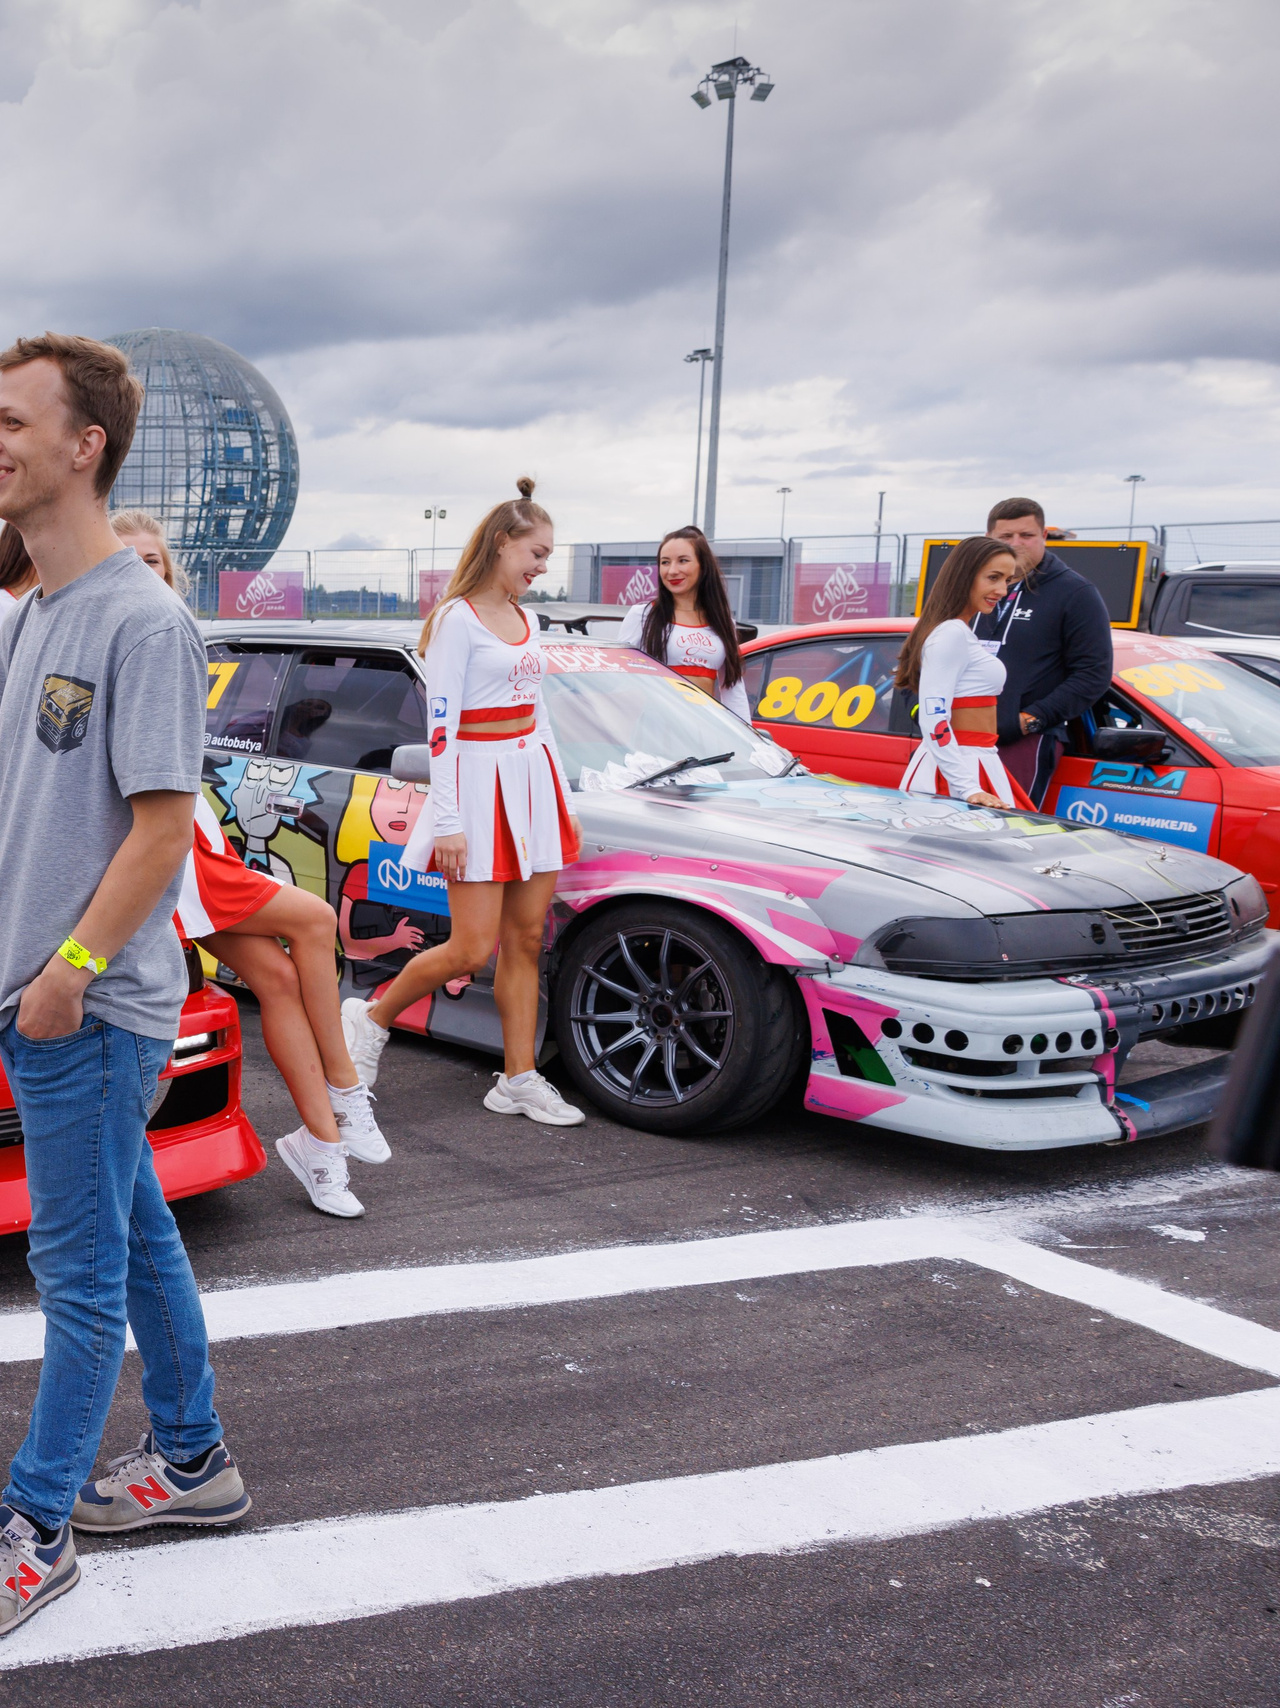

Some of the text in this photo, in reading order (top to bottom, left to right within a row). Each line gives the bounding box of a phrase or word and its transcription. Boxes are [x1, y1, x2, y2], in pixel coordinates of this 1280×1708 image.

[1118, 663, 1226, 697] 800
[757, 676, 876, 728] 800
[211, 735, 262, 753] autobatya
[1113, 812, 1198, 833] НОРНИКЕЛЬ
